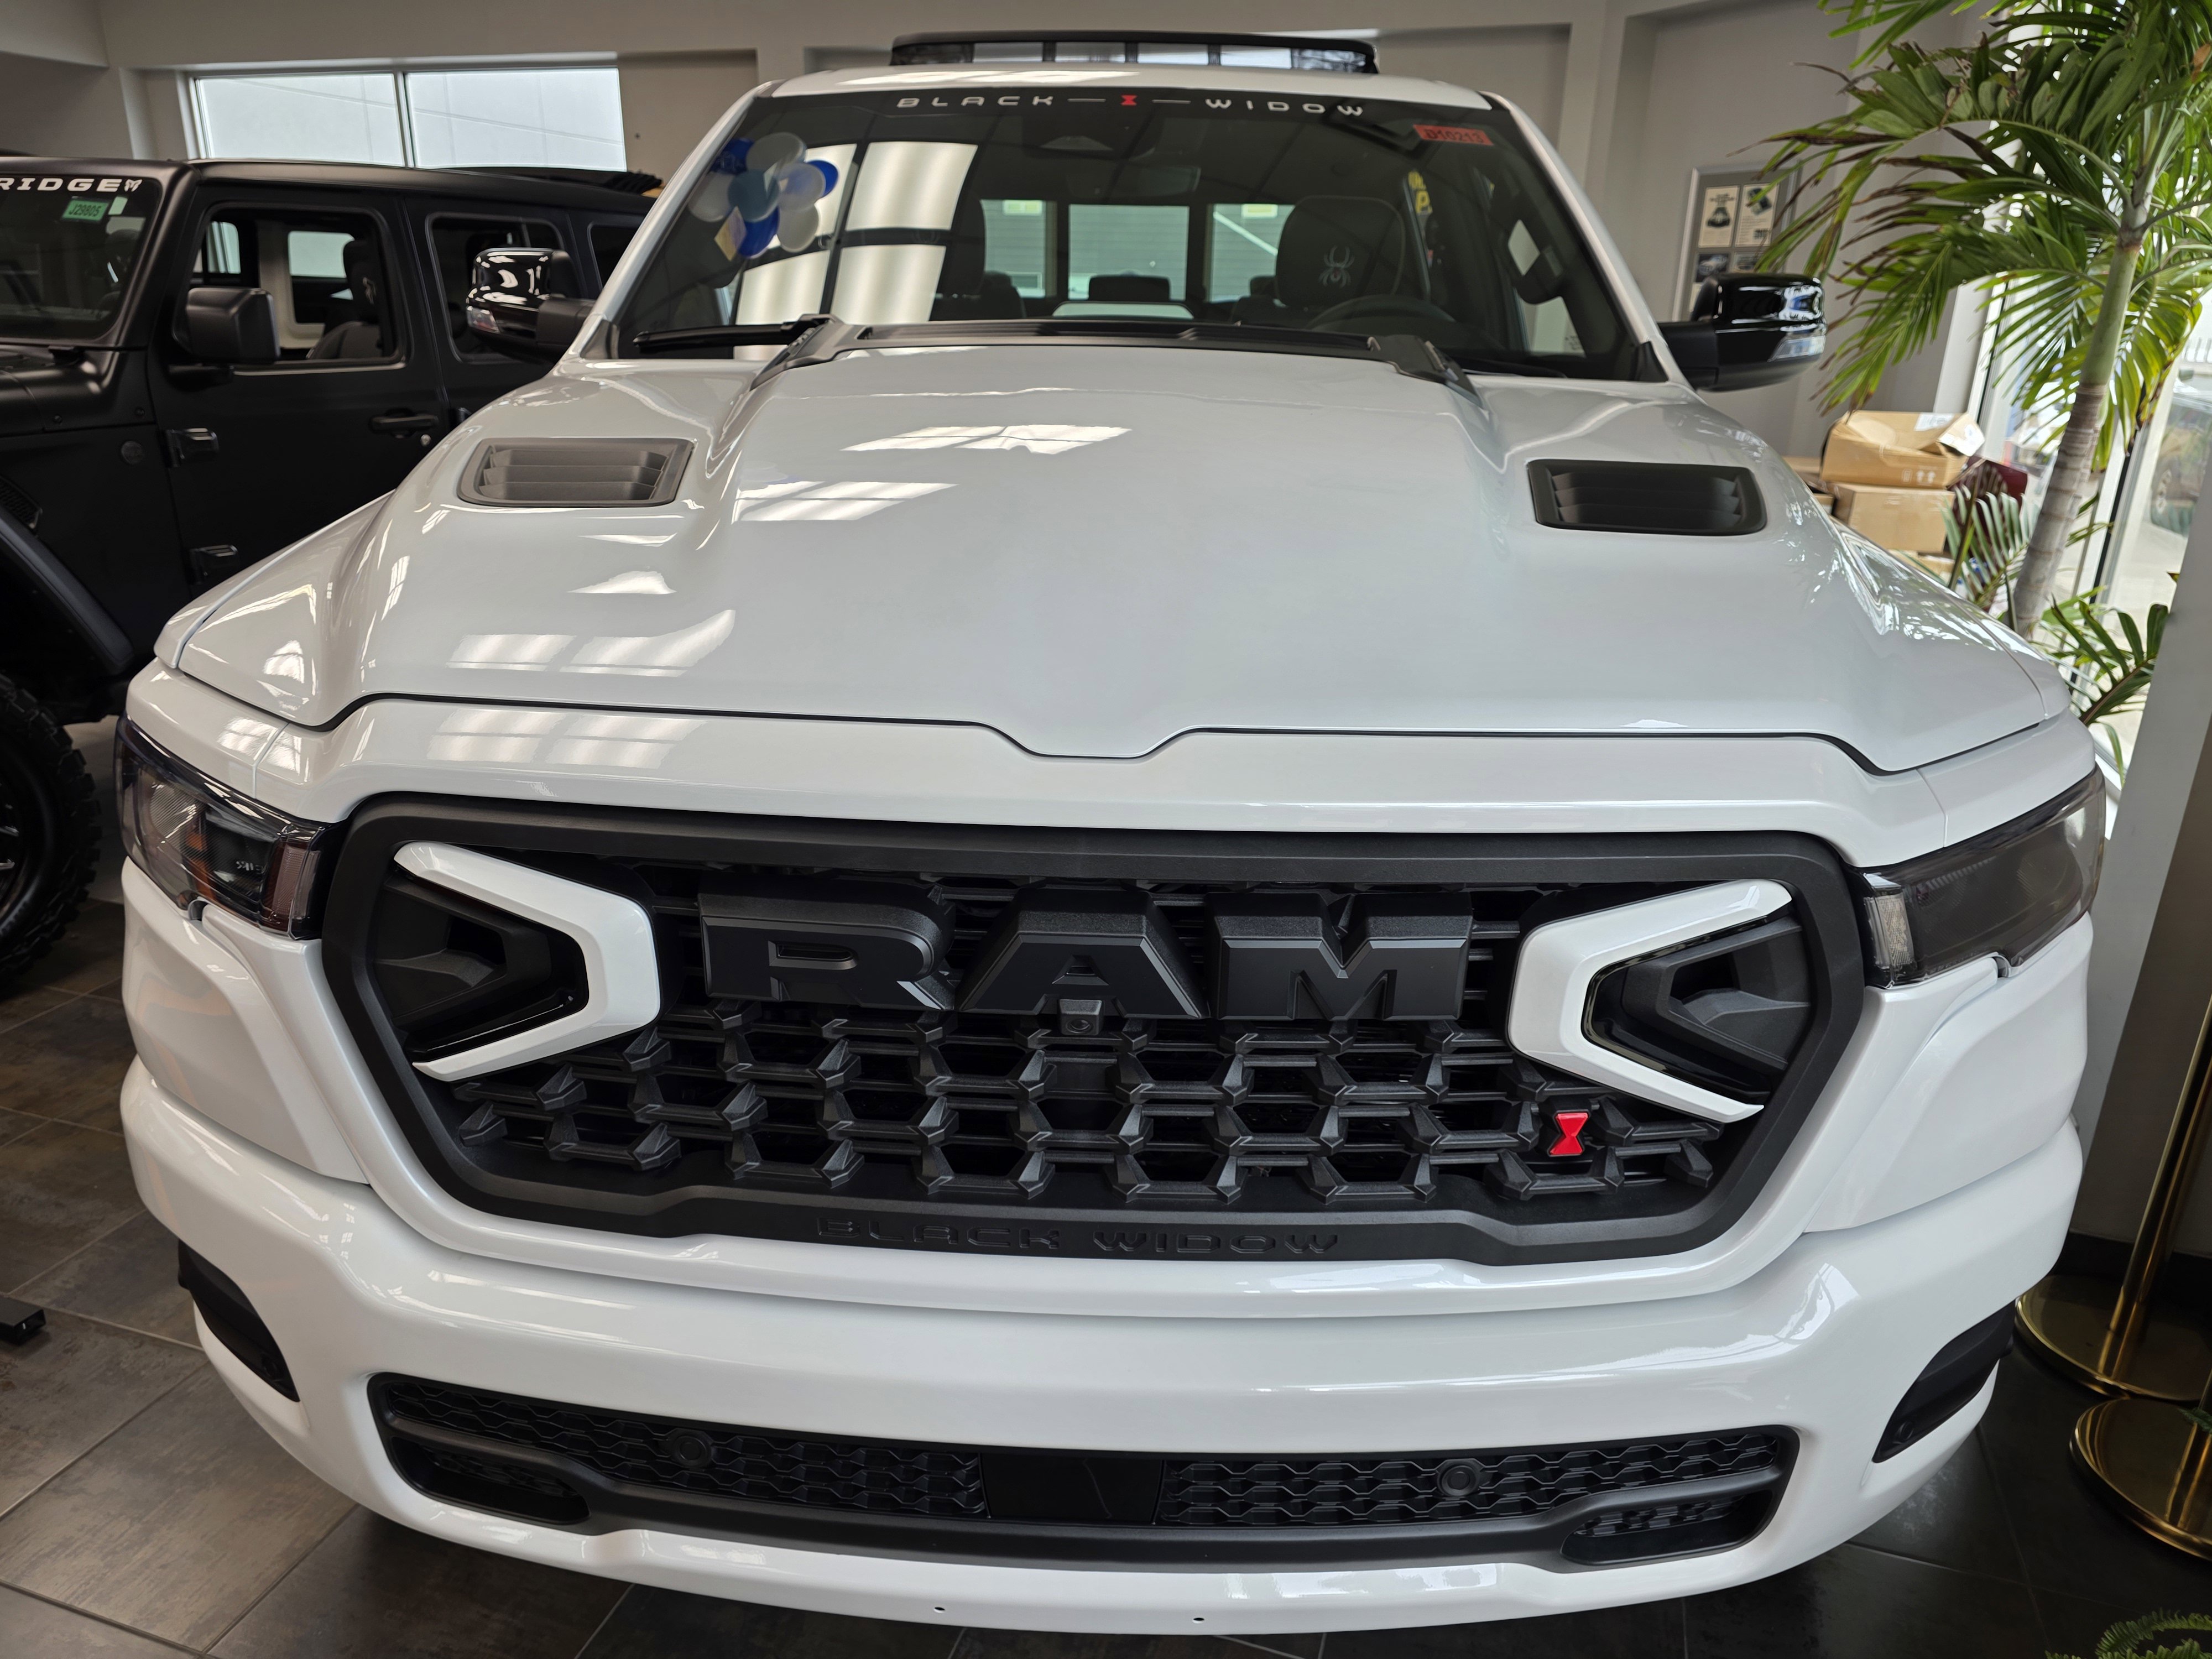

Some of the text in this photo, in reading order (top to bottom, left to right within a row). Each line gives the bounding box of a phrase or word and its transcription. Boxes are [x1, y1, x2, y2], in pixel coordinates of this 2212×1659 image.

[896, 96, 1363, 117] BLACK WIDOW
[0, 178, 122, 191] RIDGE
[700, 893, 1472, 1020] RAM
[817, 1218, 1338, 1254] BLACK WIDOW
